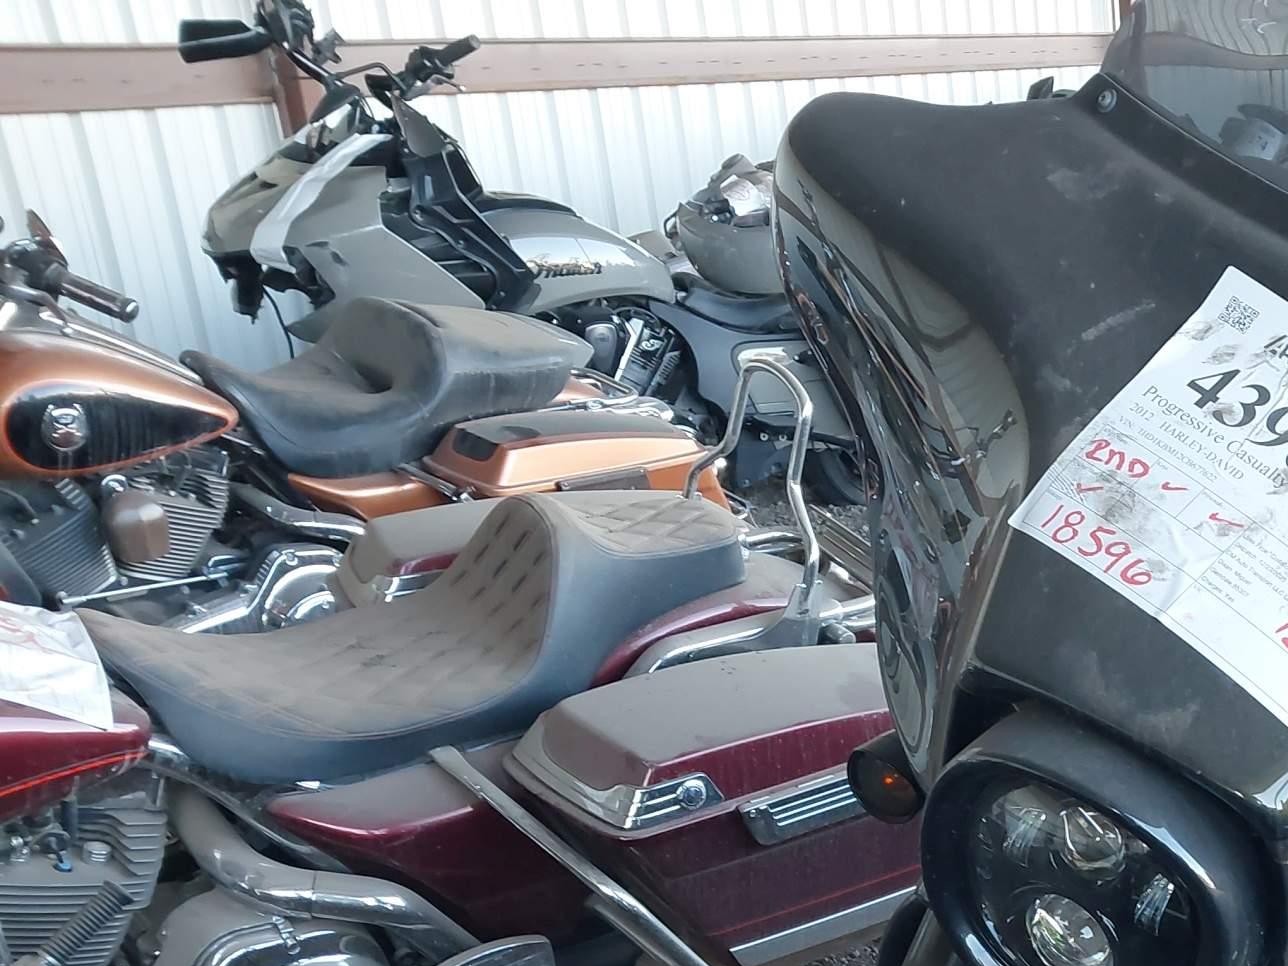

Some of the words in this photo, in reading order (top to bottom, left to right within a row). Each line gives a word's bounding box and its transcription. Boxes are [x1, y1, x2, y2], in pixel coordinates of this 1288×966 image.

[1129, 402, 1155, 421] 2012
[1160, 421, 1245, 480] HARLEY-DAVID
[1142, 385, 1225, 445] Progressive
[1040, 504, 1153, 586] 18596
